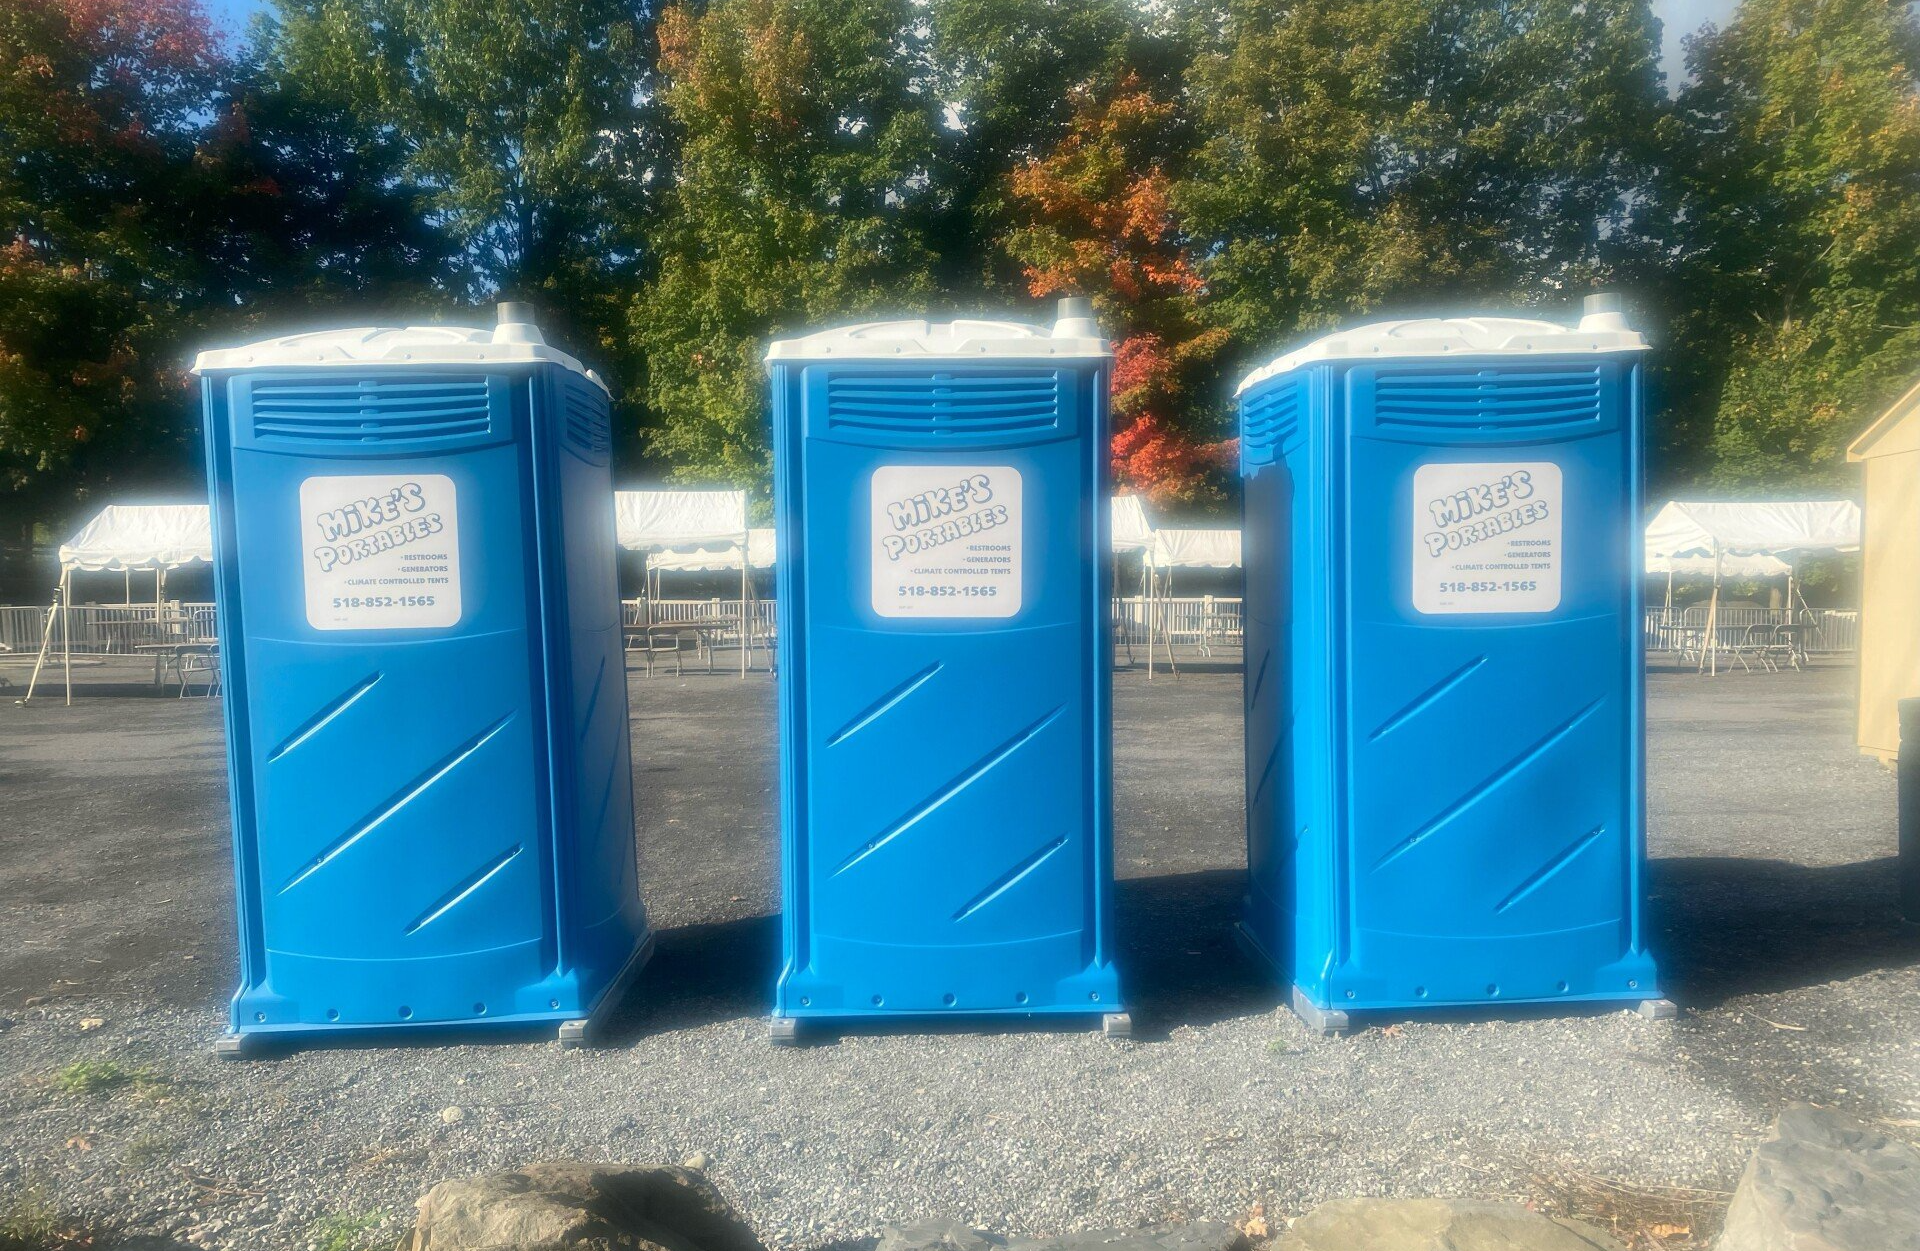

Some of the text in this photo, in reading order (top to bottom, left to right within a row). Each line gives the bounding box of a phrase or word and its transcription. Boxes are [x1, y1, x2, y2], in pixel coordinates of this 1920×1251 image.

[314, 513, 443, 572] PORTABLES
[883, 505, 1008, 561] PORTABLES
[1424, 500, 1548, 557] PORTABLES
[333, 596, 435, 608] 518-852-1565
[899, 586, 997, 596] 518-852-1565
[1440, 581, 1537, 592] 518-852-1565
